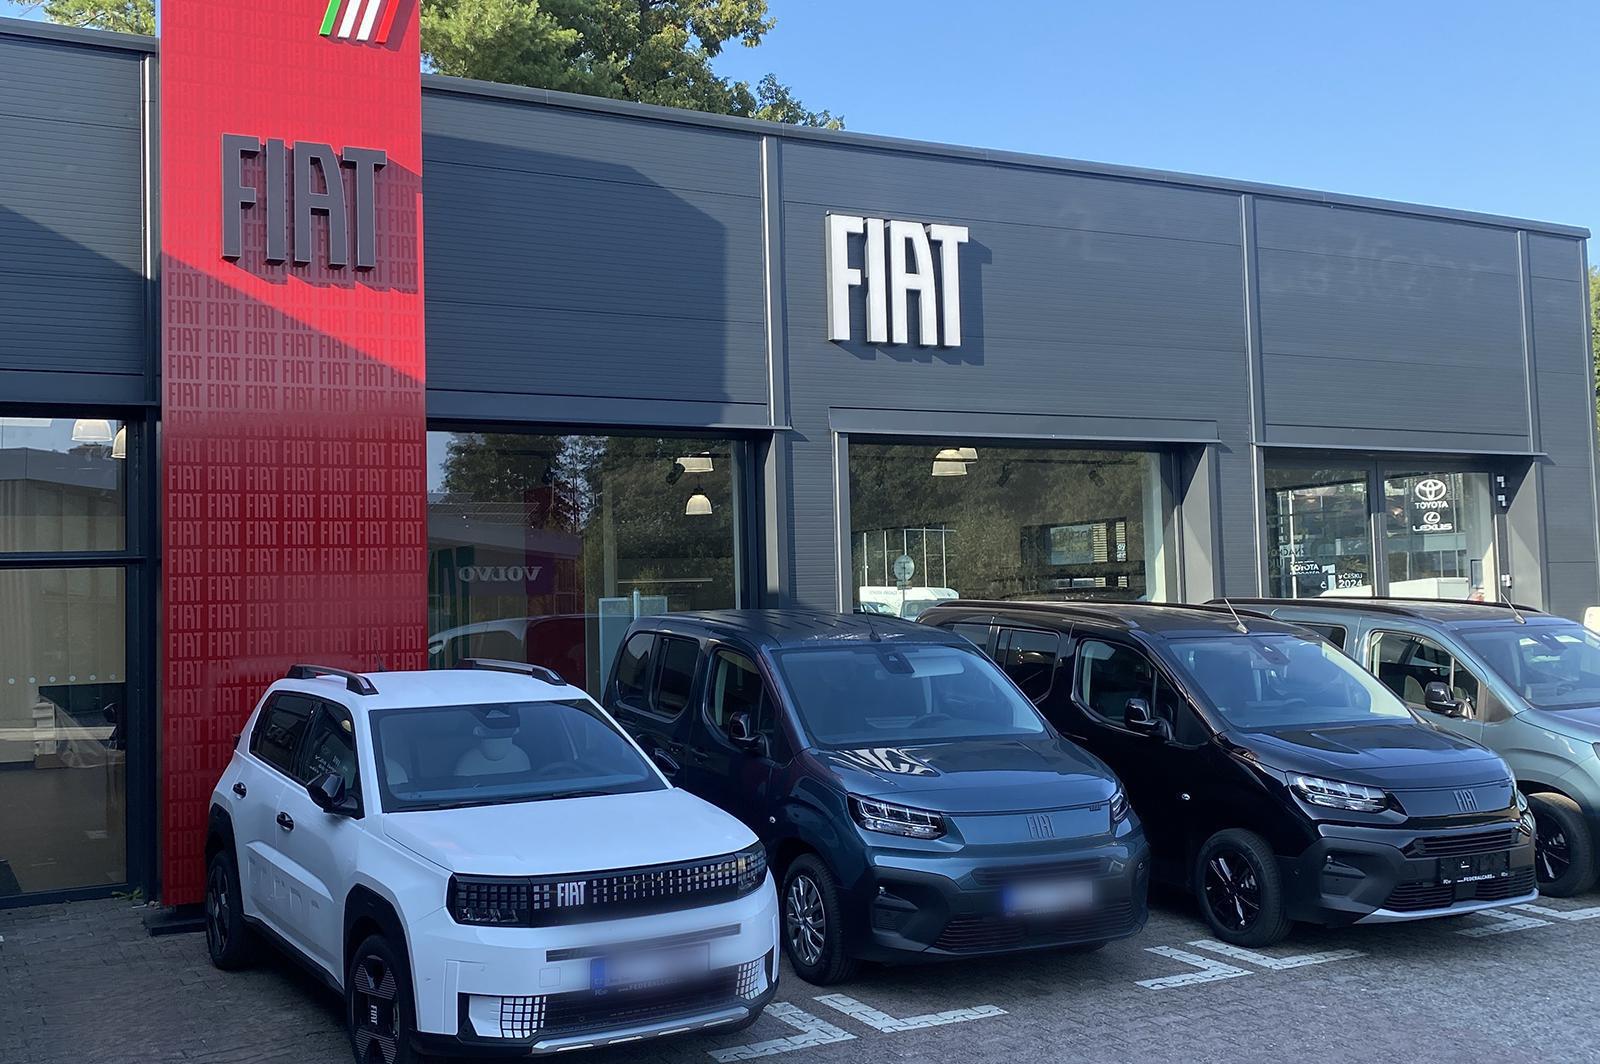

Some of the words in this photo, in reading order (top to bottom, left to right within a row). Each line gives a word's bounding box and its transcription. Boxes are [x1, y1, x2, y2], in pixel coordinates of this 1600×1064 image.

[221, 132, 388, 271] FIAT
[389, 184, 419, 209] FIAT
[389, 210, 419, 234] FIAT
[389, 236, 419, 260] FIAT
[168, 273, 202, 298] FIAT
[389, 262, 419, 286] FIAT
[825, 212, 969, 347] FIAT
[168, 300, 202, 325] FIAT
[207, 303, 240, 327] FIAT
[245, 305, 277, 329] FIAT
[168, 328, 202, 353] FIAT
[207, 330, 240, 354] FIAT
[245, 332, 277, 356] FIAT
[282, 334, 314, 358] FIAT
[319, 336, 350, 359] FIAT
[168, 355, 202, 380] FIAT
[207, 357, 240, 381] FIAT
[245, 359, 278, 383] FIAT
[283, 361, 314, 384] FIAT
[319, 362, 350, 386] FIAT
[355, 364, 386, 387] FIAT
[390, 365, 420, 389] FIAT
[168, 383, 202, 407] FIAT
[207, 385, 240, 409] FIAT
[245, 386, 278, 410] FIAT
[283, 387, 314, 411] FIAT
[319, 389, 351, 412] FIAT
[355, 390, 386, 413] FIAT
[391, 418, 421, 440] FIAT
[168, 438, 202, 462] FIAT
[207, 439, 240, 463] FIAT
[246, 440, 278, 464] FIAT
[283, 441, 315, 464] FIAT
[320, 442, 351, 465] FIAT
[356, 443, 386, 466] FIAT
[391, 444, 421, 466] FIAT
[169, 466, 202, 490] FIAT
[208, 467, 241, 490] FIAT
[246, 467, 278, 491] FIAT
[283, 468, 315, 491] FIAT
[320, 469, 351, 491] FIAT
[356, 469, 387, 492] FIAT
[391, 470, 421, 492] FIAT
[169, 494, 202, 517] FIAT
[208, 494, 241, 517] FIAT
[246, 495, 278, 518] FIAT
[283, 495, 315, 518] FIAT
[320, 495, 351, 518] FIAT
[356, 496, 387, 518] FIAT
[392, 496, 422, 518] FIAT
[1415, 500, 1449, 510] TOYOTA
[169, 522, 202, 545] FIAT
[208, 522, 241, 545] FIAT
[246, 522, 278, 545] FIAT
[284, 522, 315, 545] FIAT
[320, 522, 352, 544] FIAT
[356, 522, 387, 544] FIAT
[392, 522, 422, 544] FIAT
[1412, 523, 1453, 532] LEXUS
[169, 549, 203, 573] FIAT
[208, 549, 241, 573] FIAT
[246, 549, 279, 572] FIAT
[284, 549, 316, 572] FIAT
[320, 549, 352, 571] FIAT
[357, 548, 387, 571] FIAT
[392, 548, 422, 570] FIAT
[169, 577, 203, 601] FIAT
[208, 577, 241, 600] FIAT
[246, 576, 279, 599] FIAT
[284, 576, 316, 599] FIAT
[321, 575, 352, 598] FIAT
[1338, 579, 1363, 588] 2024
[169, 605, 203, 629] FIAT
[208, 604, 241, 628] FIAT
[246, 603, 279, 627] FIAT
[169, 632, 203, 657] FIAT
[208, 631, 241, 656] FIAT
[247, 630, 279, 654] FIAT
[284, 629, 316, 653] FIAT
[321, 628, 352, 652] FIAT
[357, 627, 388, 651] FIAT
[393, 627, 423, 649] FIAT
[169, 660, 203, 685] FIAT
[393, 653, 423, 671] FIAT
[169, 688, 203, 713] FIAT
[208, 686, 242, 711] FIAT
[169, 716, 203, 741] FIAT
[208, 714, 242, 739] FIAT
[169, 744, 203, 769] FIAT
[169, 772, 203, 798] FIAT
[1025, 814, 1056, 839] FIAT
[1457, 874, 1496, 883] FEDERALCARS.
[557, 881, 586, 907] FIAT
